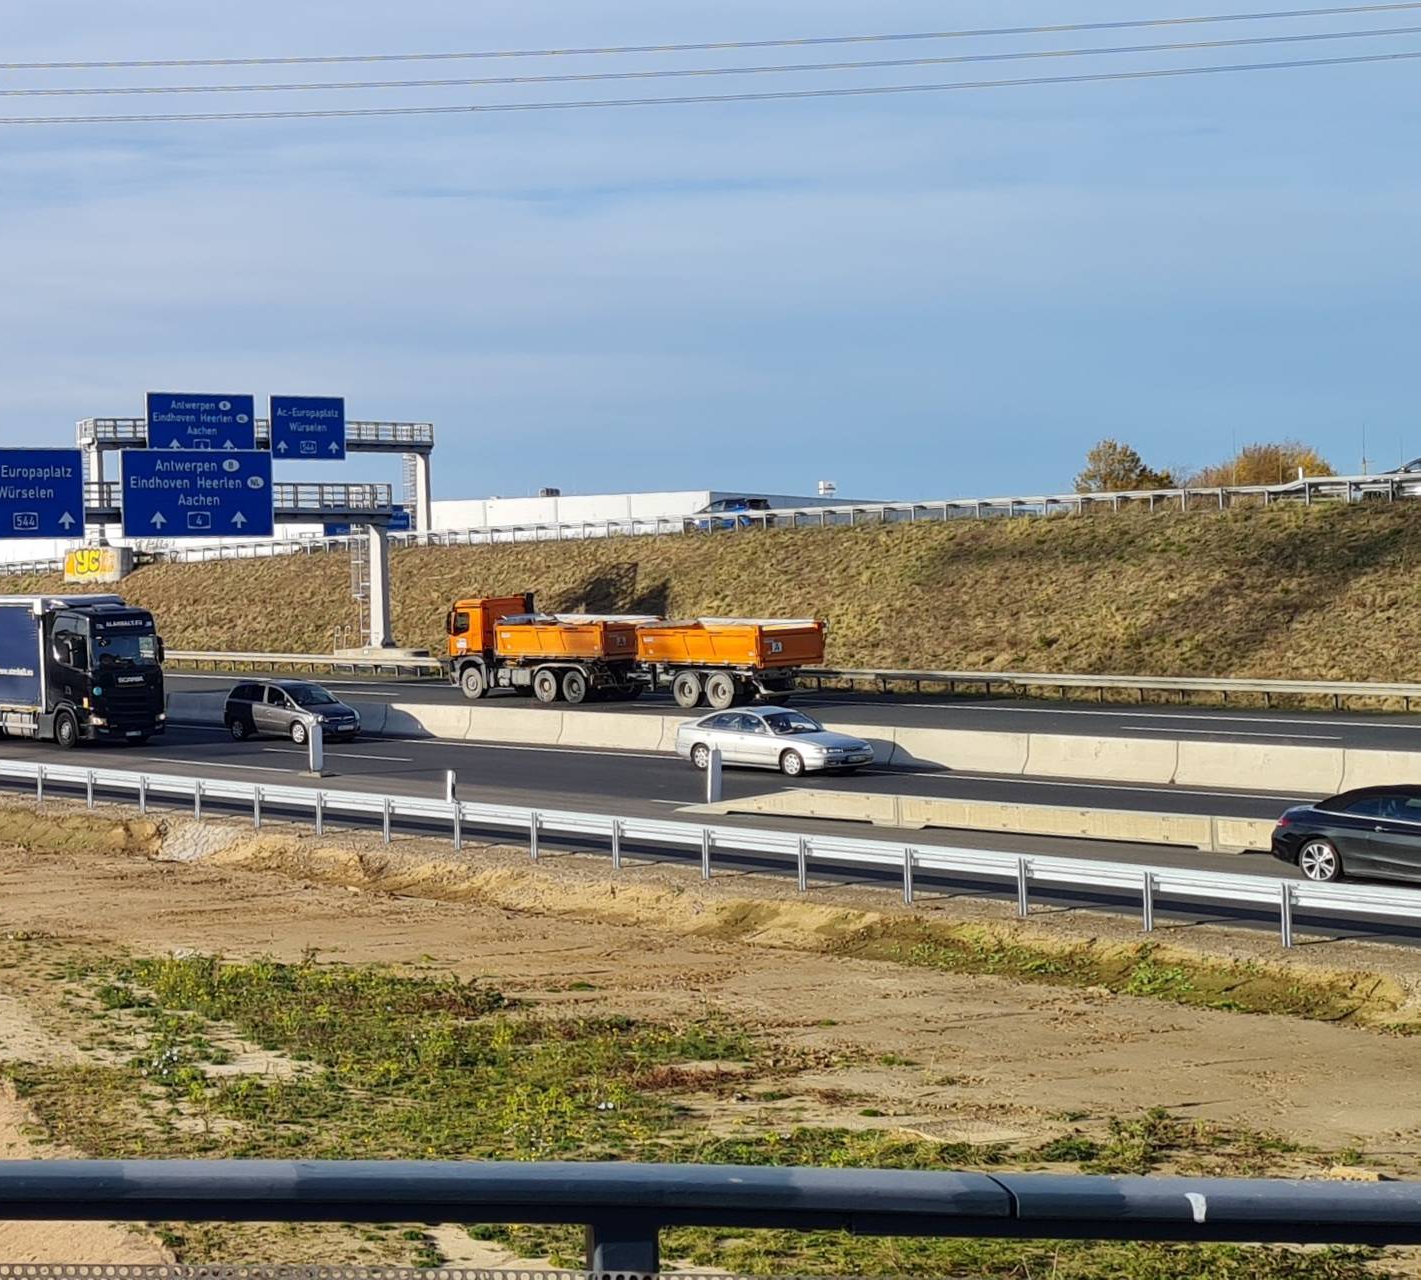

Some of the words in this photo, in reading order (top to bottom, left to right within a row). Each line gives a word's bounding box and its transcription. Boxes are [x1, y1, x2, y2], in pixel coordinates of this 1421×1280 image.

[171, 400, 215, 411] Antwerpen
[153, 412, 195, 422] Eindhoven
[200, 414, 233, 423] Heerlen
[187, 426, 217, 435] Aachen
[290, 422, 328, 432] Würselen
[155, 459, 218, 473] Antwerpen
[130, 476, 190, 489] Eindhoven
[197, 477, 242, 489] Heerlen
[178, 494, 220, 506] Aachen
[16, 515, 35, 527] 544
[196, 515, 203, 525] 4
